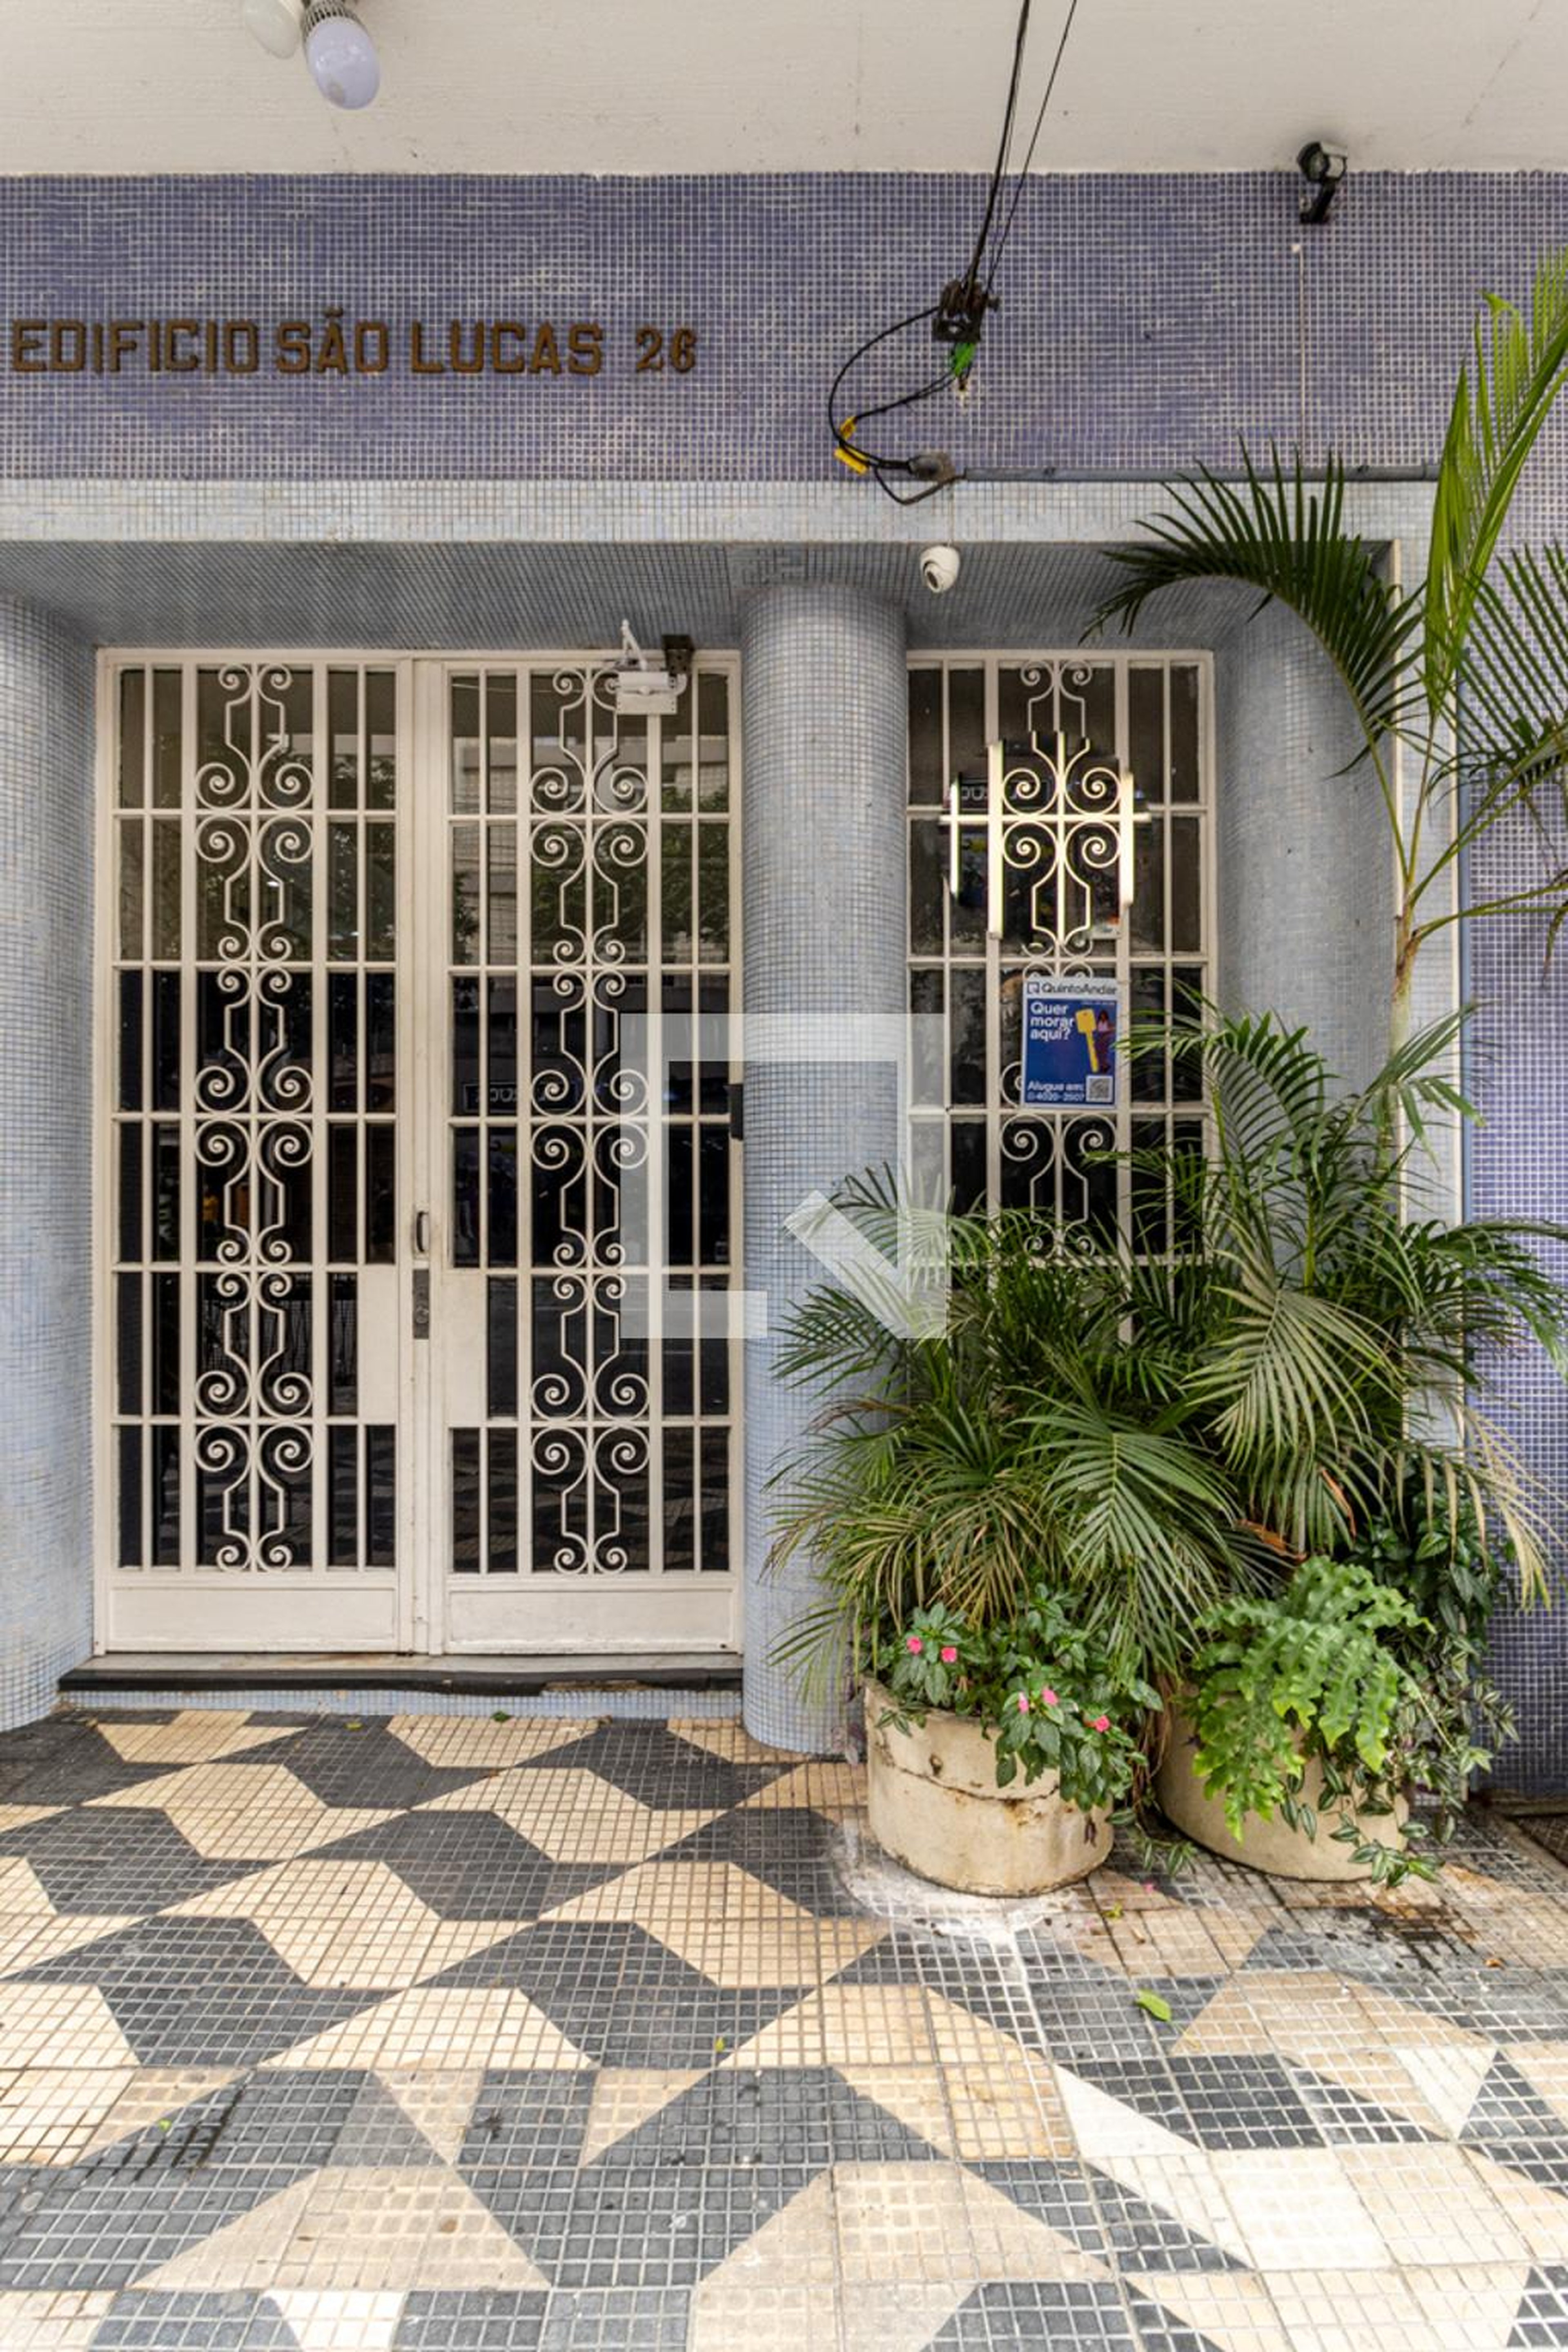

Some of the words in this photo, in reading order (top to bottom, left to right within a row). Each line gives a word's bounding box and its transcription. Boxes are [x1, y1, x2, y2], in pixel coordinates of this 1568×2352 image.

[11, 319, 260, 373] EDIFICIO
[275, 306, 390, 375] SÃO
[410, 320, 604, 375] LUCAS
[634, 327, 697, 374] 26
[1042, 982, 1117, 994] QuintoAndar
[1030, 1002, 1068, 1016] Quer
[1030, 1016, 1075, 1028] morar
[1030, 1027, 1071, 1042] aqui?
